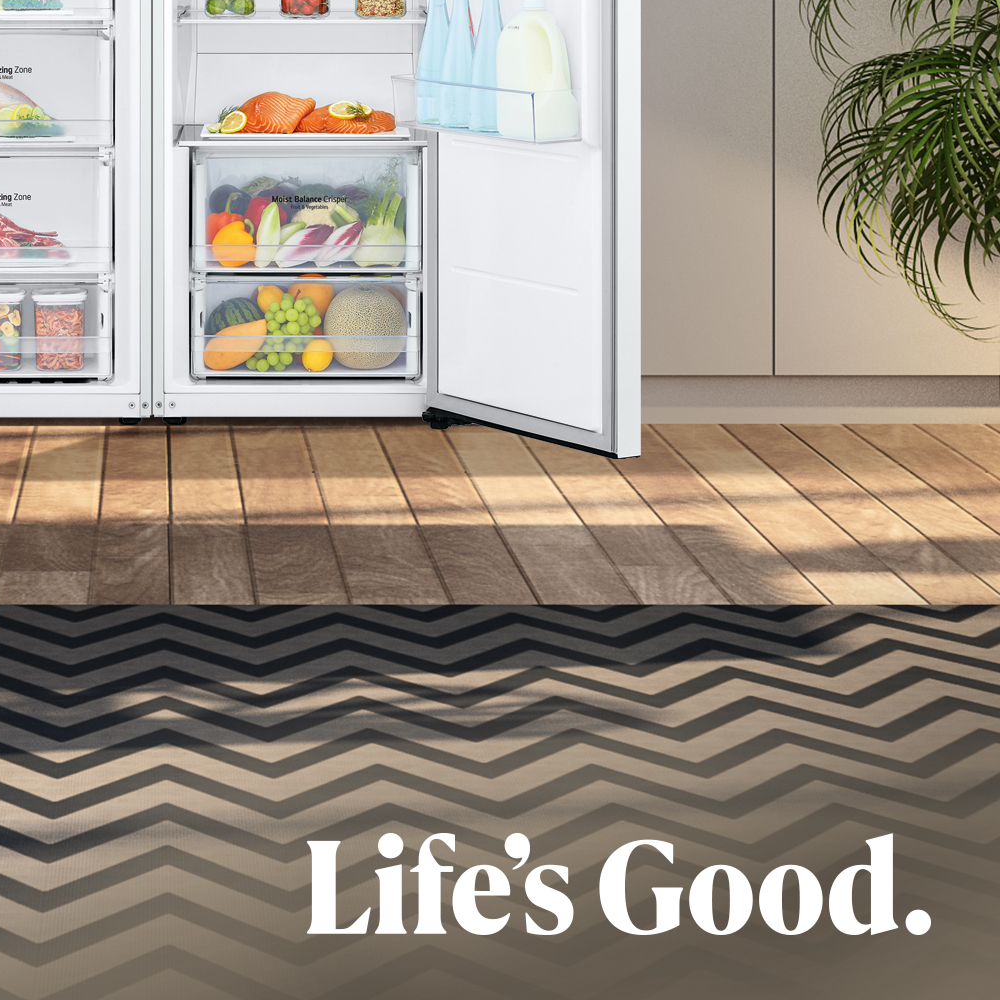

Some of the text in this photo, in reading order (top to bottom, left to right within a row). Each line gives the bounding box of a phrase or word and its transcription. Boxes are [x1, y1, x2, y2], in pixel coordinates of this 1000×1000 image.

[14, 65, 33, 74] Zone
[13, 193, 32, 201] Zone
[271, 195, 348, 204] Moist Balance Crisper
